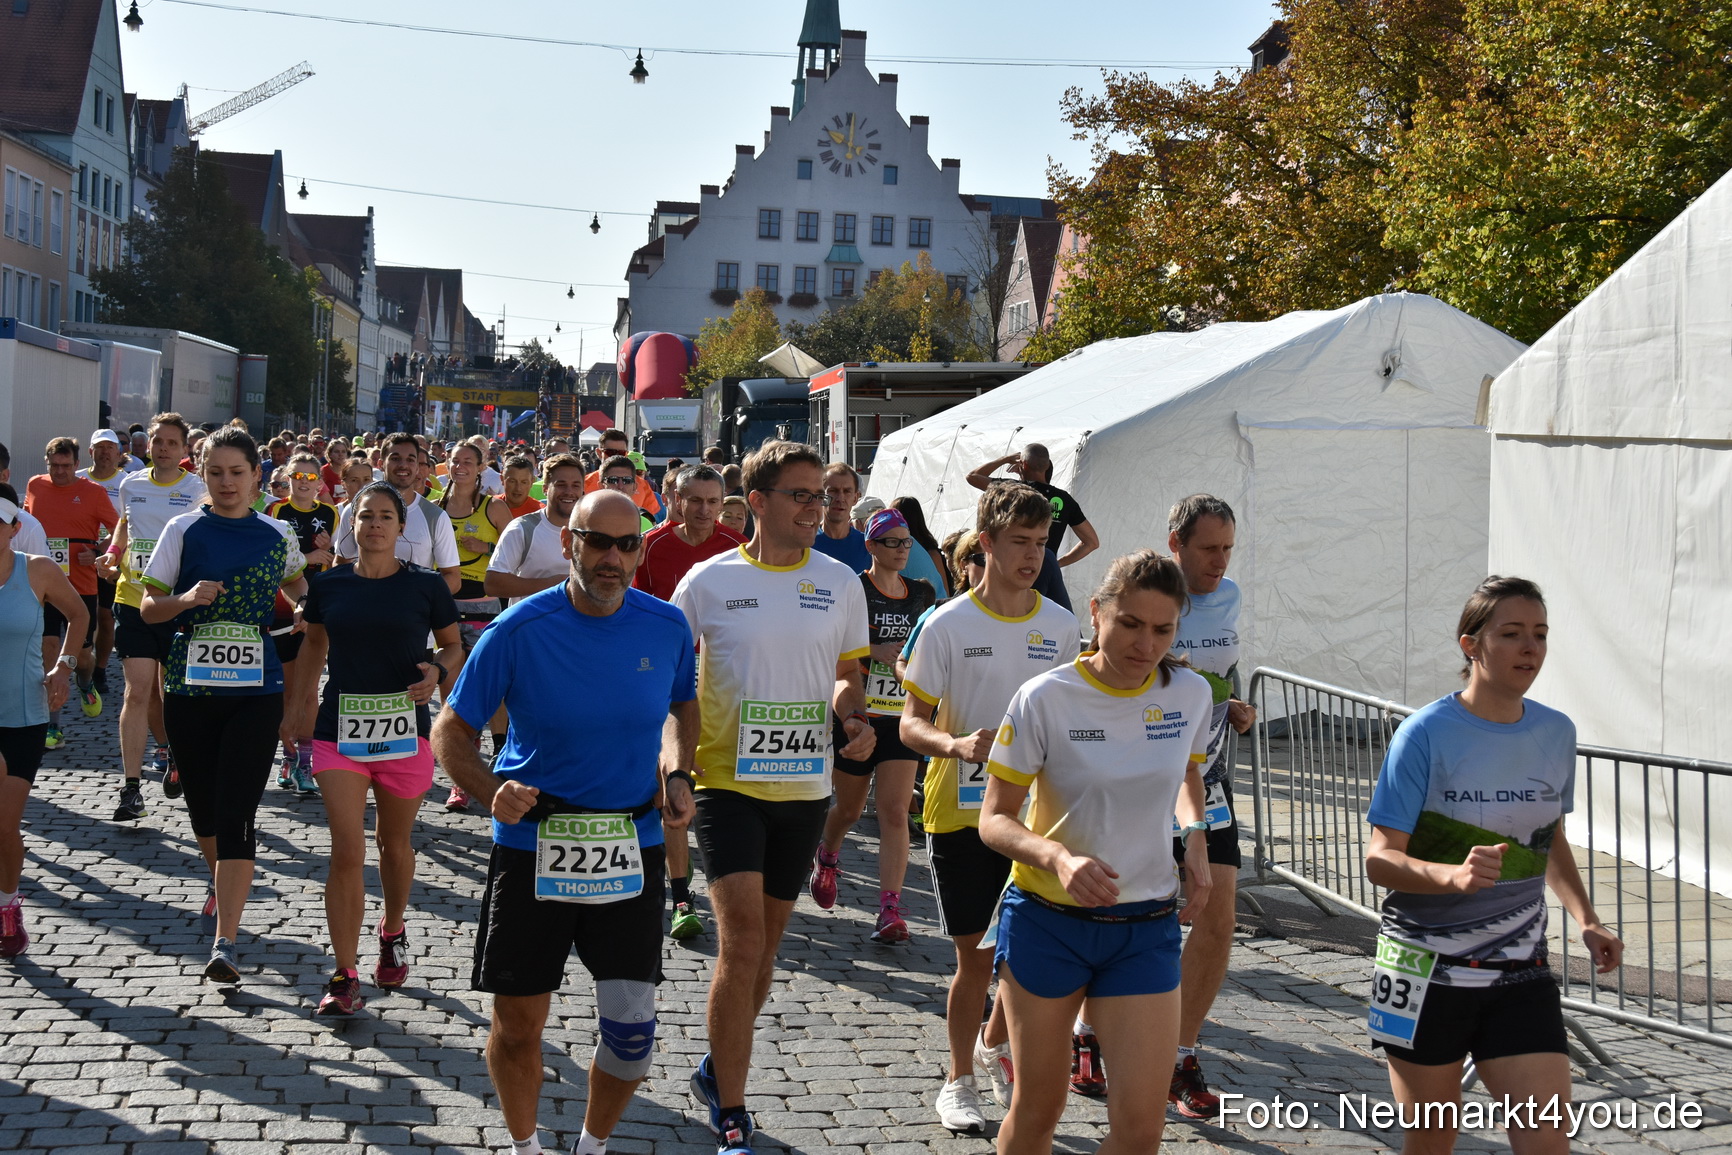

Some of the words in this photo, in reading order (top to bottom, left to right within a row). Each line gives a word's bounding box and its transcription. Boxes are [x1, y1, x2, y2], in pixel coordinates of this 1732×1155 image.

[463, 391, 501, 402] START
[799, 583, 815, 594] 20
[726, 599, 758, 607] BOCK
[800, 594, 836, 605] Neumarkter
[800, 602, 829, 612] Stadtlauf
[874, 613, 911, 625] HECK
[196, 625, 257, 640] BOCK
[1028, 633, 1043, 645] 20
[1171, 638, 1230, 649] AIL.ONE
[197, 644, 255, 665] 2605
[964, 647, 992, 656] BOCK
[1028, 653, 1055, 662] Stadtlauf
[211, 670, 239, 680] NINA
[345, 695, 409, 713] BOCK
[747, 703, 820, 722] BOCK
[1144, 709, 1163, 722] 20
[1164, 712, 1180, 720] JAHRE
[347, 716, 409, 739] 2770
[1145, 720, 1189, 732] Neumarkter
[1069, 730, 1105, 739] BOCK
[1146, 730, 1181, 741] Stadtlauf
[367, 741, 391, 754] Ulla
[749, 729, 817, 754] 2544
[749, 761, 813, 772] ANDREAS
[1444, 790, 1536, 803] RAIL.ONE
[546, 818, 629, 838] BOCK
[549, 844, 630, 874] 2224
[555, 880, 624, 894] THOMAS
